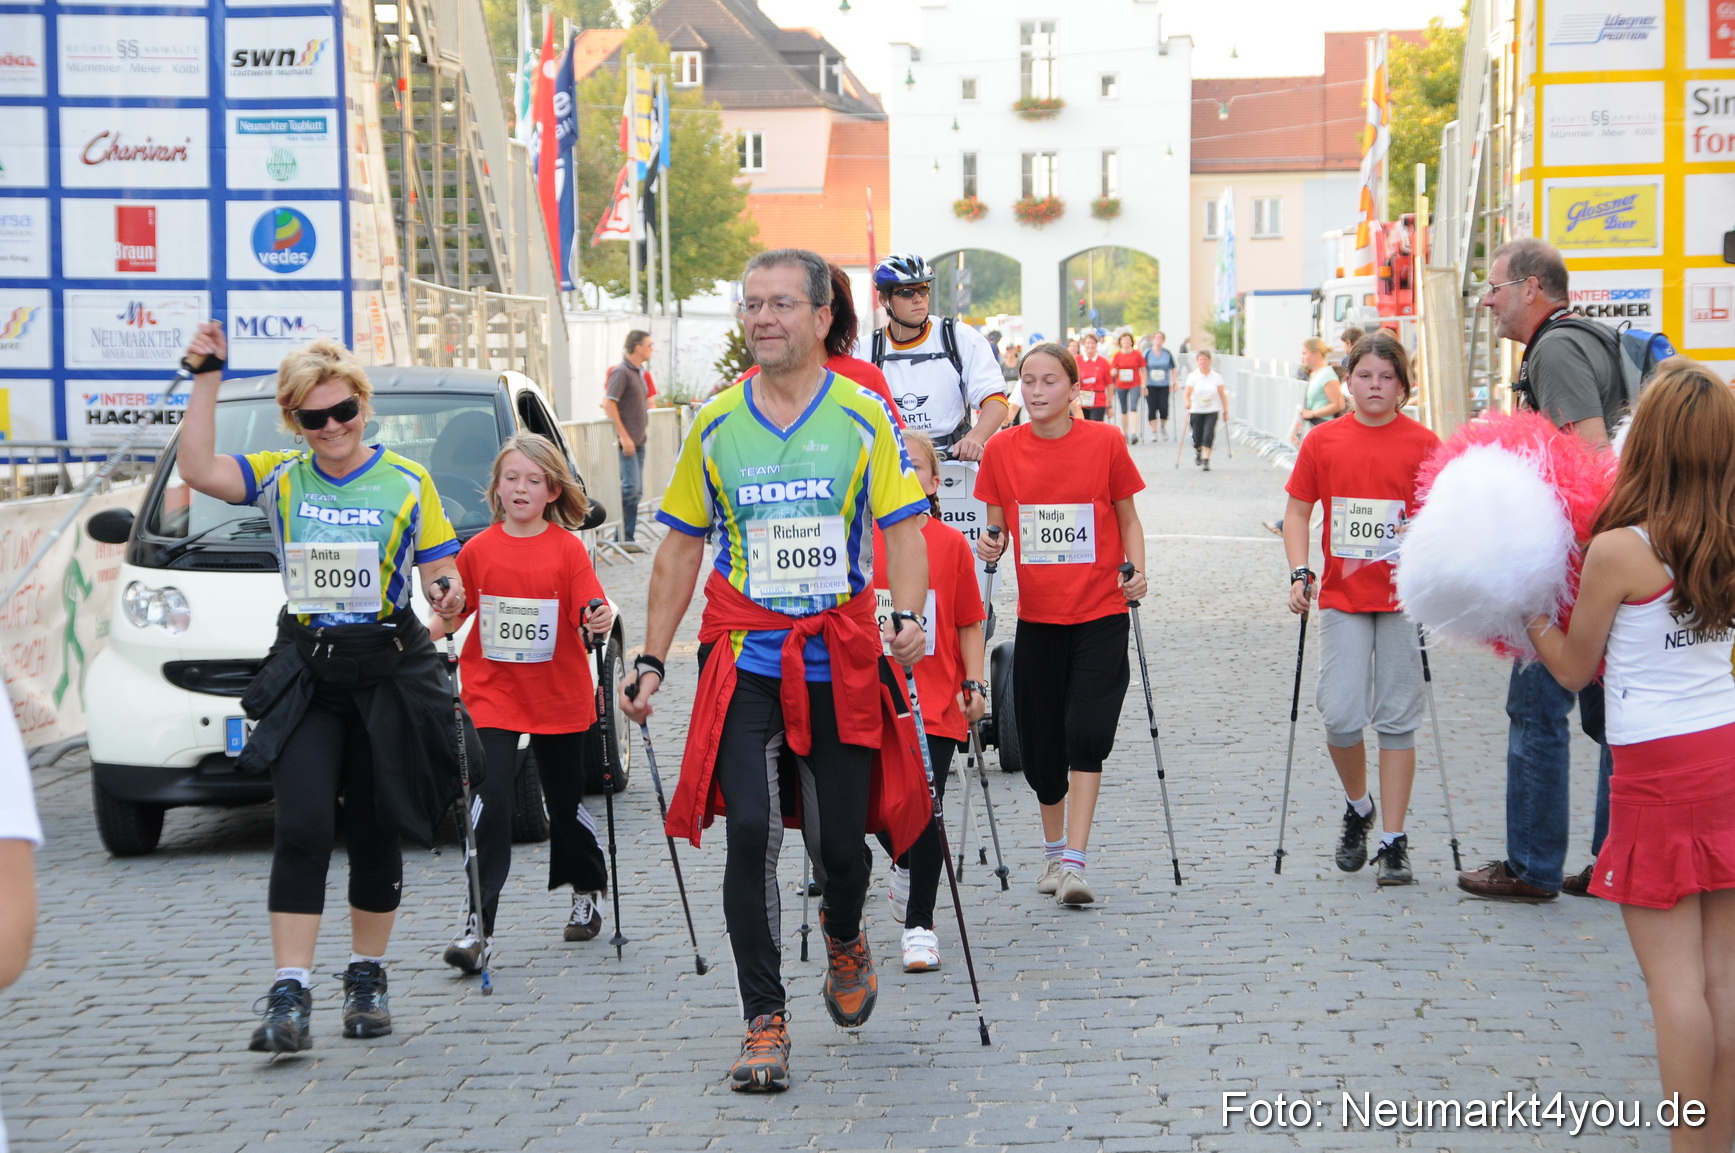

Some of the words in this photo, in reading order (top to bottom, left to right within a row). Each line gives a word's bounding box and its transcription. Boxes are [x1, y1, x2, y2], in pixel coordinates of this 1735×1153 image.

[230, 48, 295, 67] swn
[230, 68, 273, 76] stadtwerke
[275, 68, 313, 76] neumarkt
[240, 120, 287, 131] Neumarkter
[288, 119, 322, 132] Tagblatt
[80, 129, 191, 165] Charivari
[1566, 193, 1639, 232] Glossner
[1604, 214, 1638, 230] Bier
[115, 242, 154, 260] Braun
[259, 248, 309, 265] vedes
[235, 315, 303, 337] MCM
[91, 327, 182, 348] NEUMARKTER
[101, 348, 172, 360] MINERALBRUNNEN
[739, 465, 780, 478] TEAM
[304, 493, 337, 501] TEAM
[737, 478, 835, 507] BOCK
[298, 501, 384, 526] BOCK
[1039, 509, 1065, 522] Nadja
[1350, 503, 1373, 515] Jana
[774, 523, 821, 539] Richard
[1023, 527, 1028, 535] N
[1041, 527, 1088, 543] 8064
[1350, 522, 1396, 539] 8063
[311, 548, 340, 560] Anita
[752, 549, 759, 560] N
[777, 546, 837, 569] 8089
[290, 568, 297, 578] N
[314, 569, 371, 588] 8090
[810, 581, 846, 589] PFLEIDERER
[499, 602, 540, 616] Ramona
[500, 622, 549, 641] 8065
